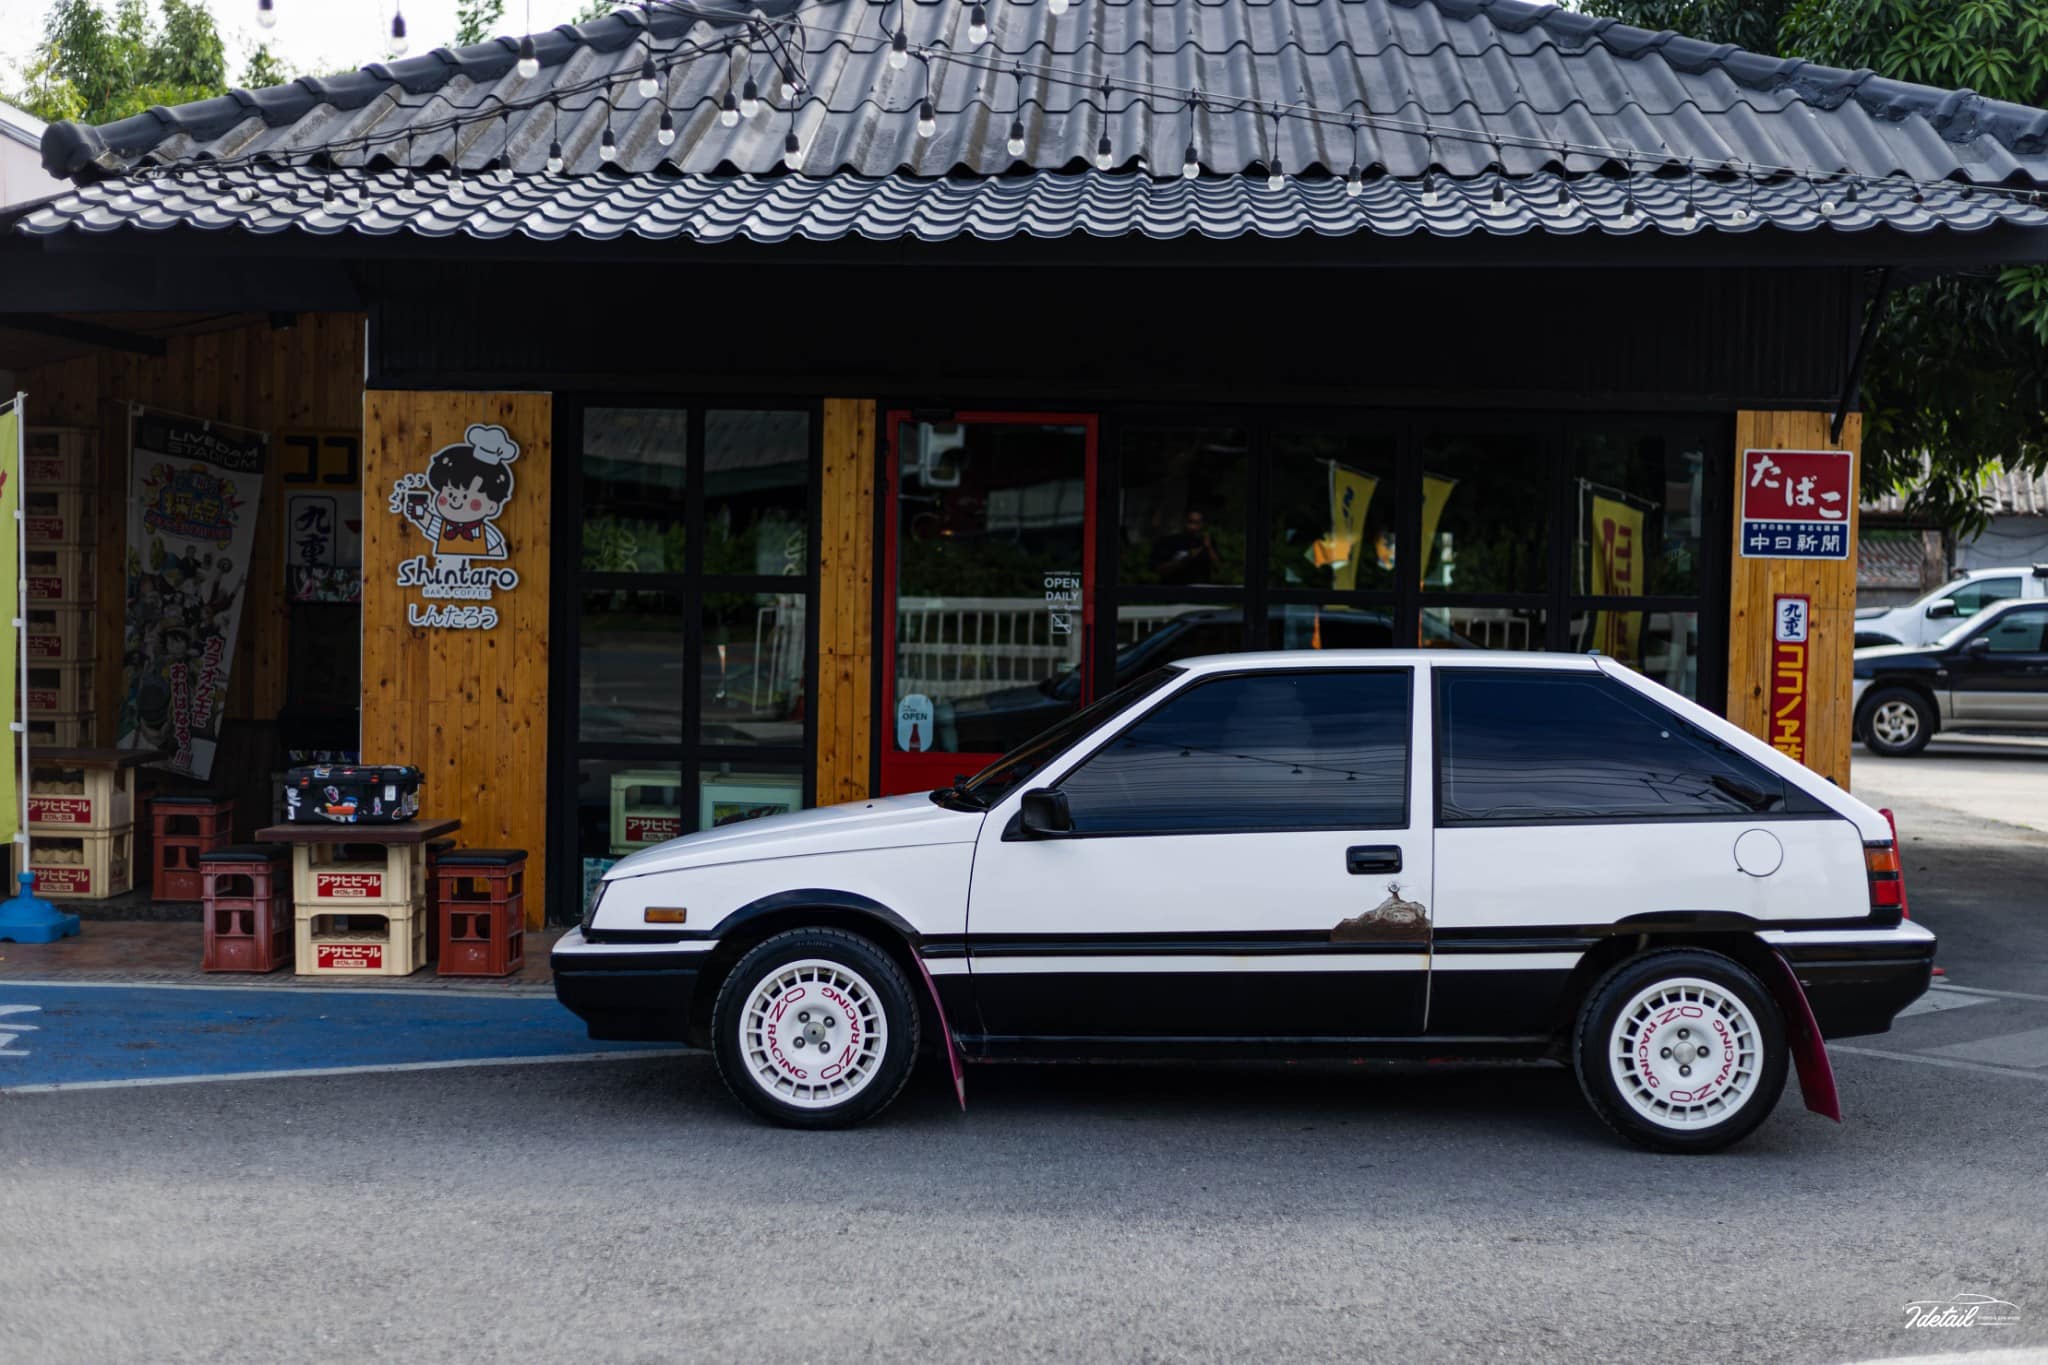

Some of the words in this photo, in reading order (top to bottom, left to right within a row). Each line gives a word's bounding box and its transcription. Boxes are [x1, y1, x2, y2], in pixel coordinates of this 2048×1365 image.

[168, 441, 257, 472] STADIUM
[1750, 455, 1843, 519] たばこ
[1750, 532, 1840, 552] 中日新聞
[399, 557, 516, 587] Shintaro
[1043, 576, 1080, 589] OPEN
[454, 589, 490, 597] COFFEE
[1045, 591, 1079, 601] DAILY
[410, 605, 496, 627] しんたろう
[1783, 603, 1801, 637] 九重
[902, 712, 928, 721] OPEN
[627, 819, 680, 831] アサヒビー
[319, 876, 381, 887] アサヒビール
[319, 946, 381, 958] アサヒビール
[821, 987, 860, 1044] RACING
[767, 1023, 808, 1080] RACING
[1639, 1022, 1660, 1088] RACING
[1713, 1019, 1733, 1086] RACING
